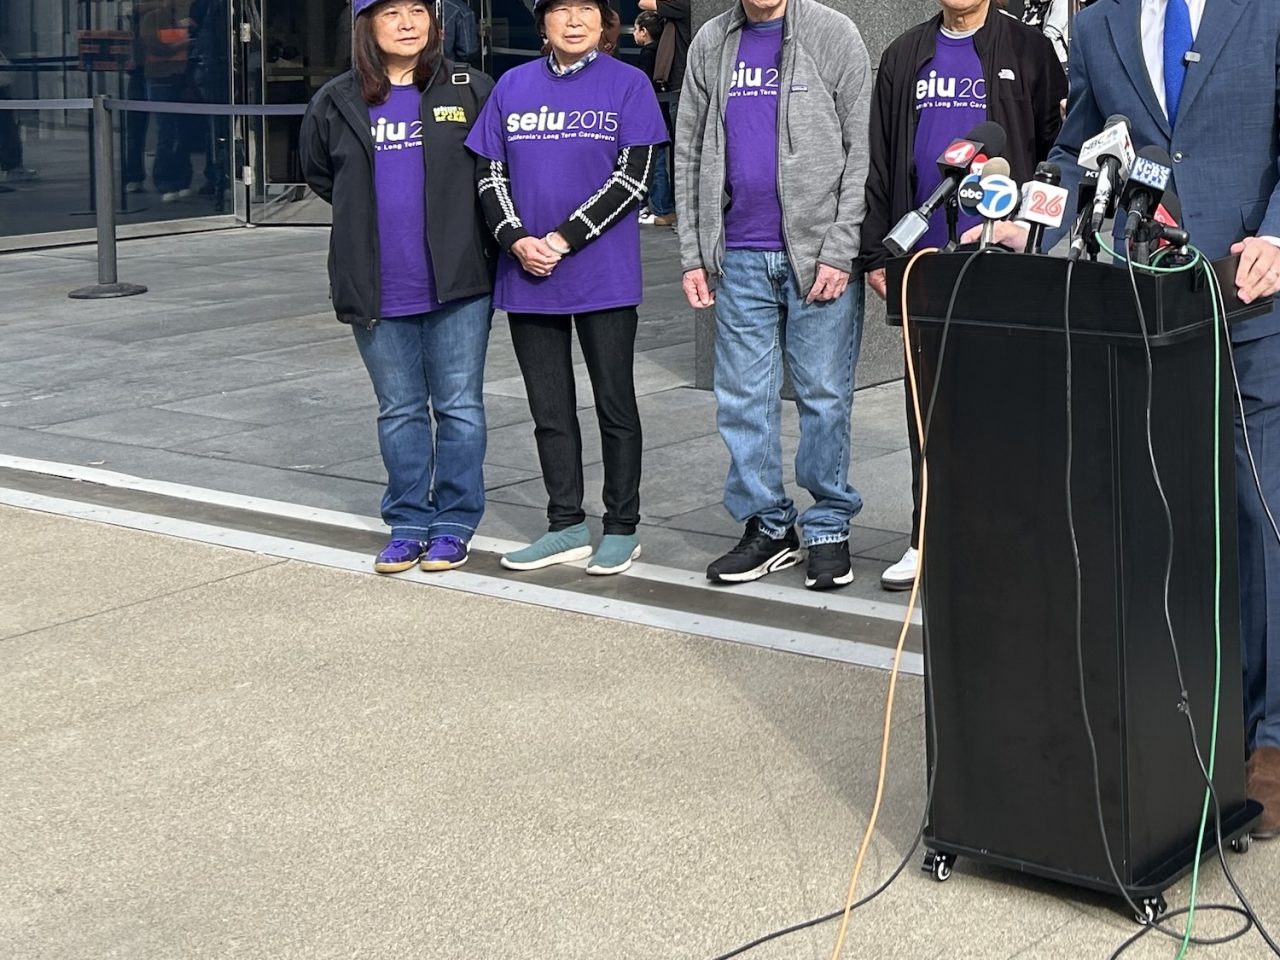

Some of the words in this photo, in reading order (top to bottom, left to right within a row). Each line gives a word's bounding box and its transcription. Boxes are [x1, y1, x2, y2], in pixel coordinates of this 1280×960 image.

[934, 101, 951, 109] Long
[561, 131, 577, 139] Term
[578, 131, 615, 142] Caregivers
[383, 143, 402, 151] Long
[944, 142, 974, 163] 4
[1136, 157, 1170, 180] KCBS
[959, 189, 984, 201] abc
[1029, 190, 1064, 218] 26
